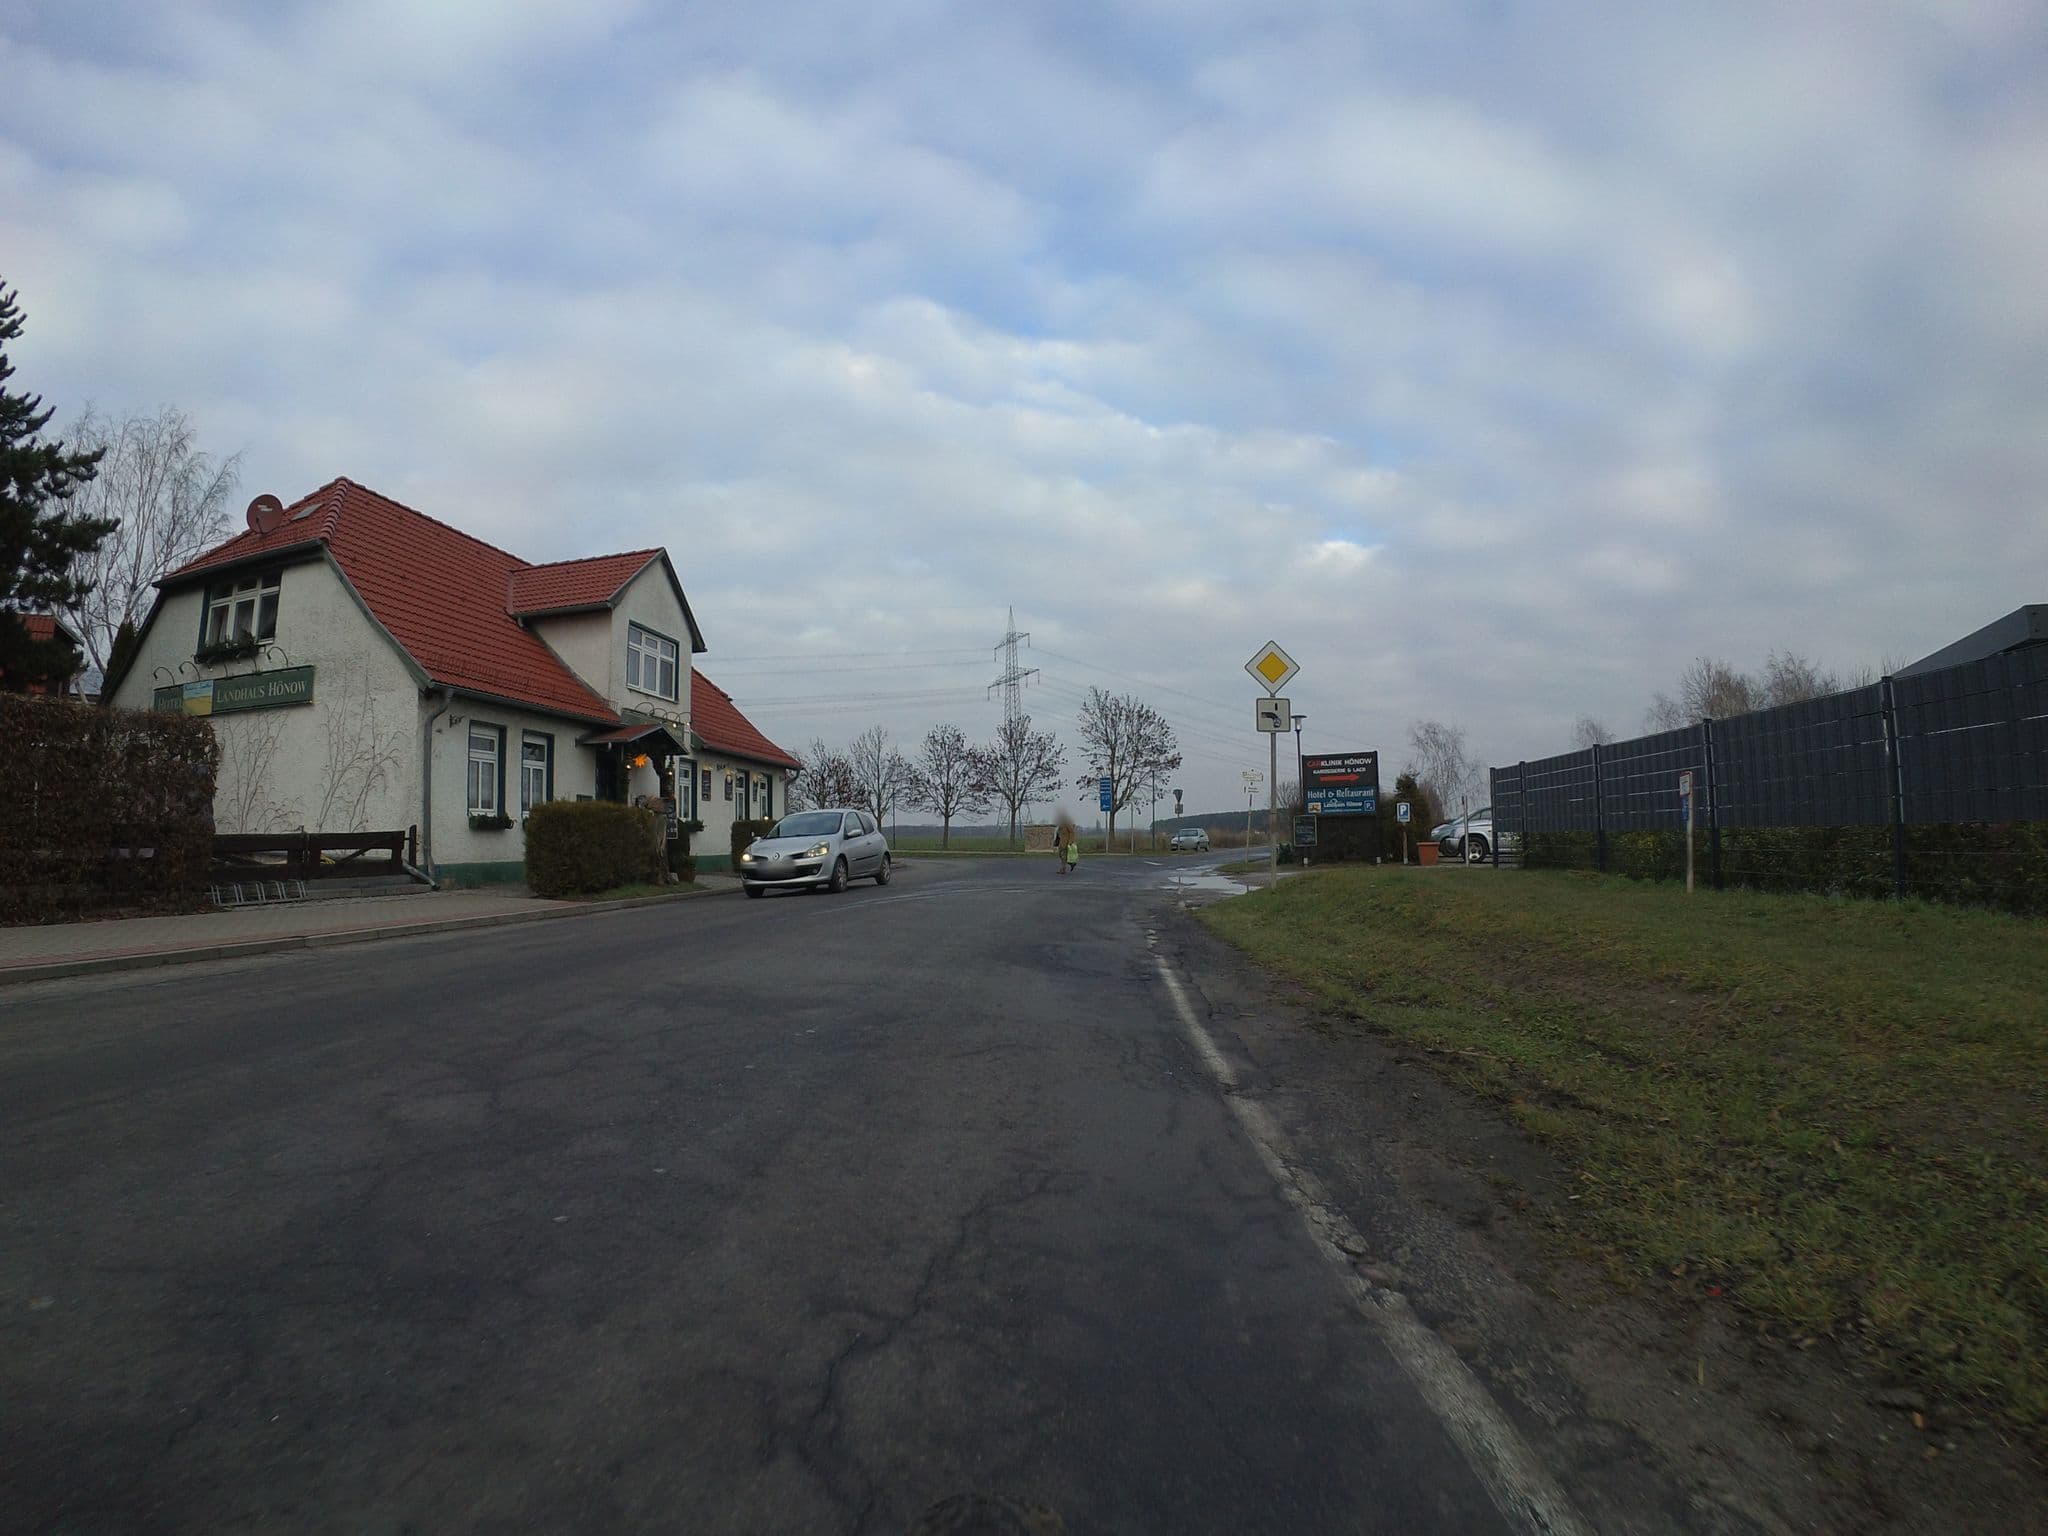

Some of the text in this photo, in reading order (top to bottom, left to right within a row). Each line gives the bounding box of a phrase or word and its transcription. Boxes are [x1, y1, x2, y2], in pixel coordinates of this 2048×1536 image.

[268, 680, 306, 697] HÖNOW
[1344, 757, 1372, 766] HÖNOW
[1307, 788, 1326, 799] Hotel
[1400, 805, 1407, 815] P
